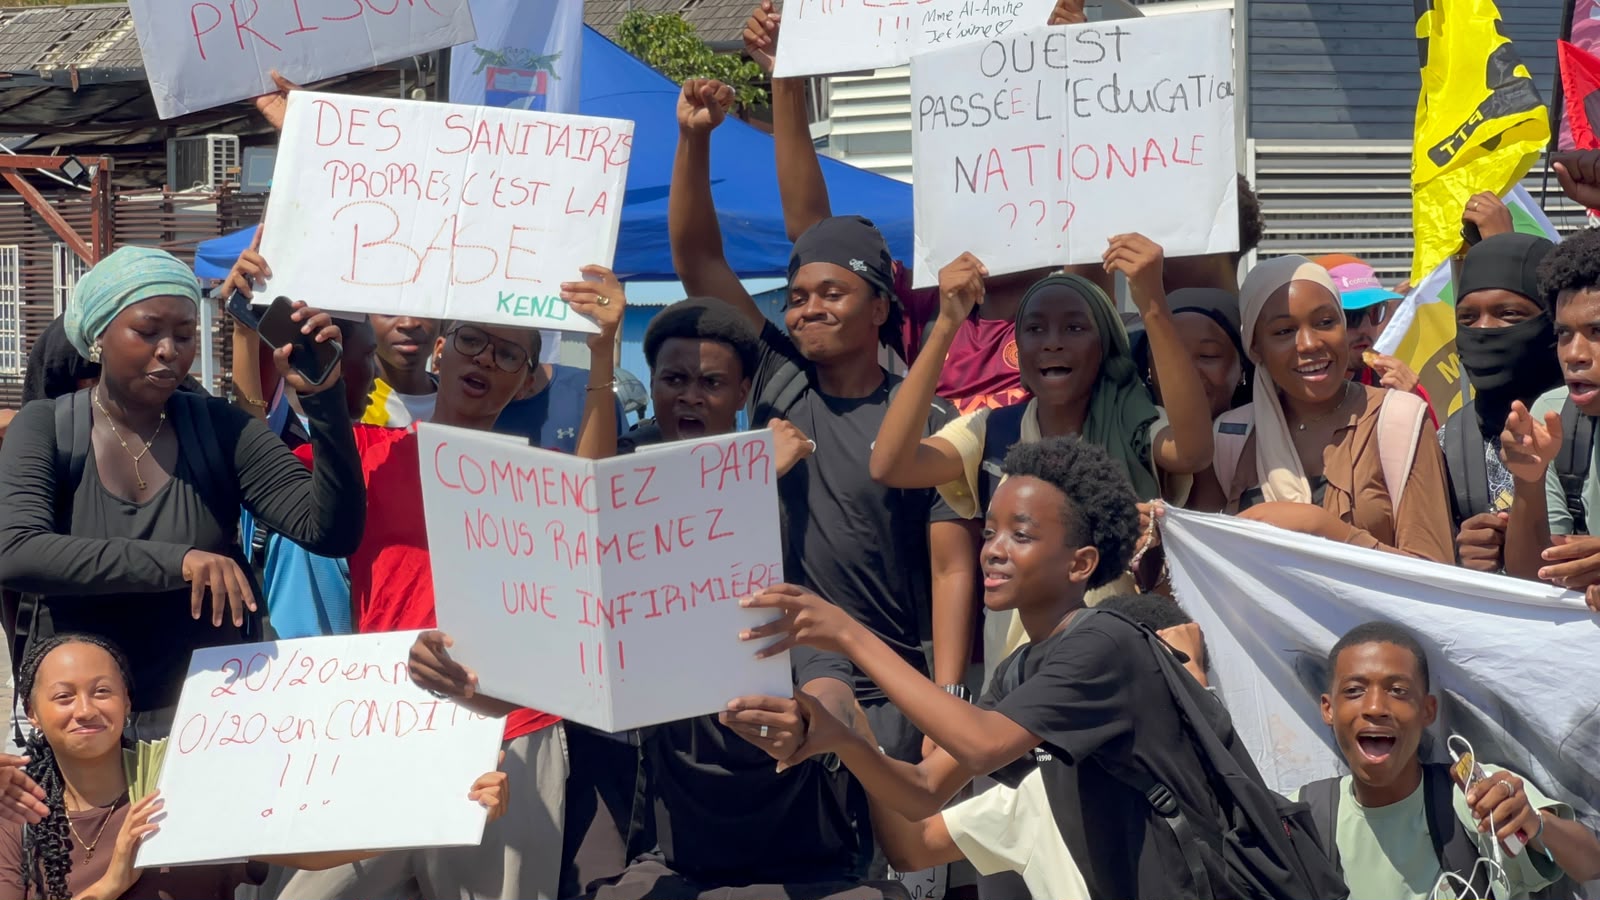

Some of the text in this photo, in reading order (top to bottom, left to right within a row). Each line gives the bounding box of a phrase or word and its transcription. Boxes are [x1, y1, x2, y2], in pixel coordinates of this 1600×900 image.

[312, 100, 634, 173] DES SANITAIRES
[565, 187, 608, 217] LA
[332, 200, 553, 287] BASE
[434, 439, 770, 514] COMMENCEZ PAR
[464, 507, 735, 570] NOUS RAMENEZ
[502, 580, 558, 619] UNE
